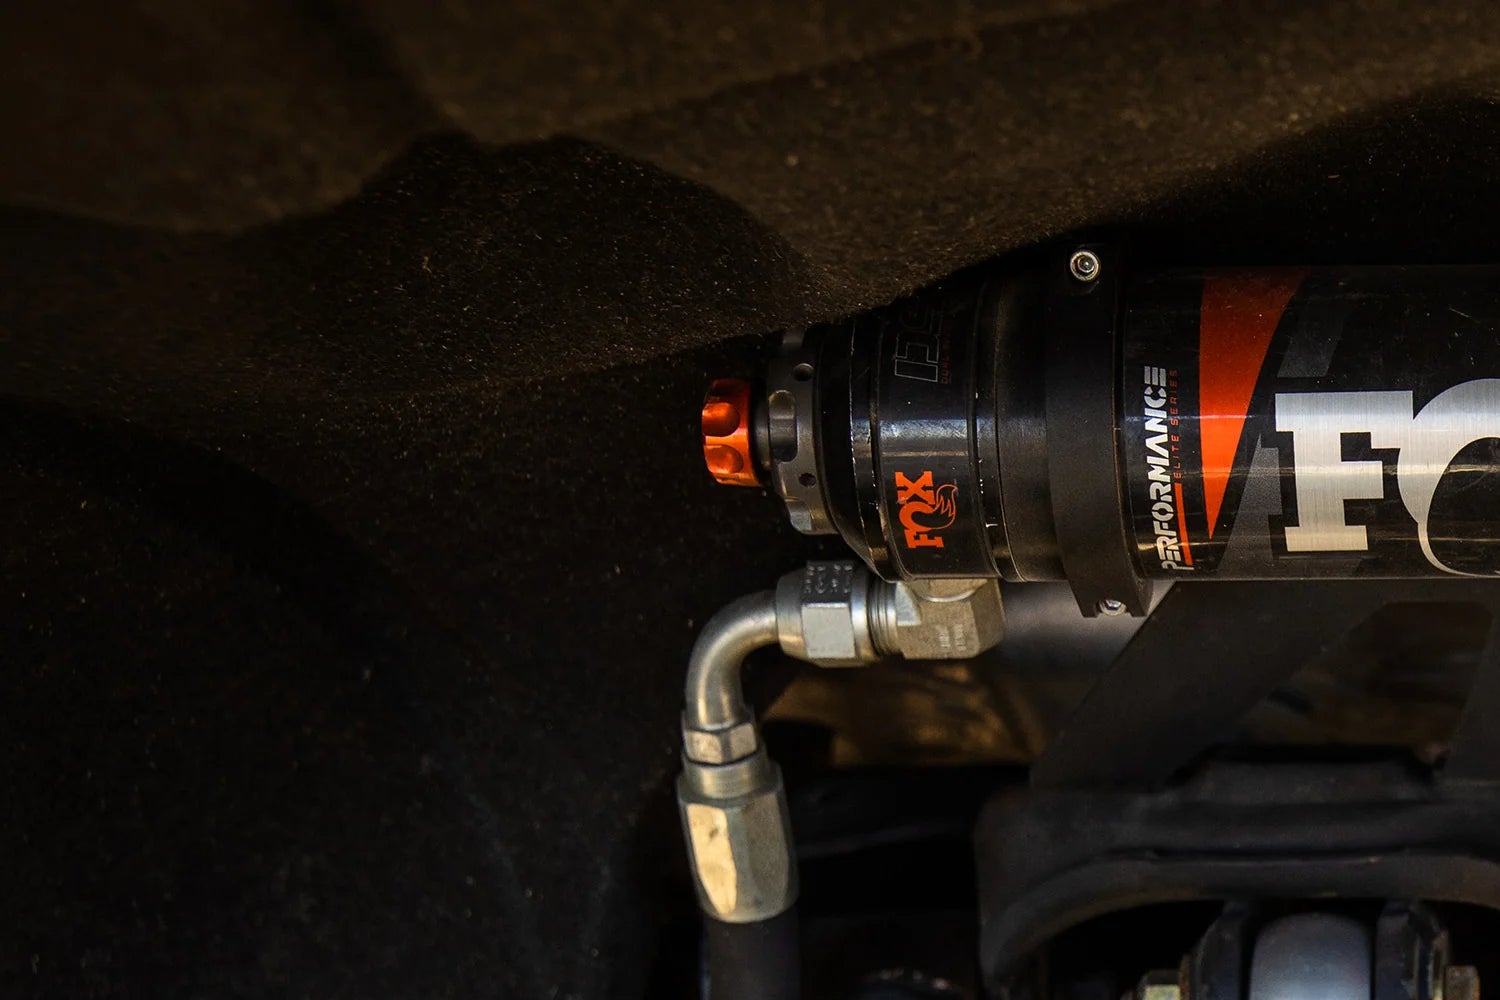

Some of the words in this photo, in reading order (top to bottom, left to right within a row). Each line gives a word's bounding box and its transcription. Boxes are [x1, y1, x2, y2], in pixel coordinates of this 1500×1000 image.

[1169, 368, 1180, 426] SERIES
[1144, 366, 1194, 570] PERFORMANCE
[1171, 435, 1183, 479] ELITE
[895, 470, 957, 548] FOX
